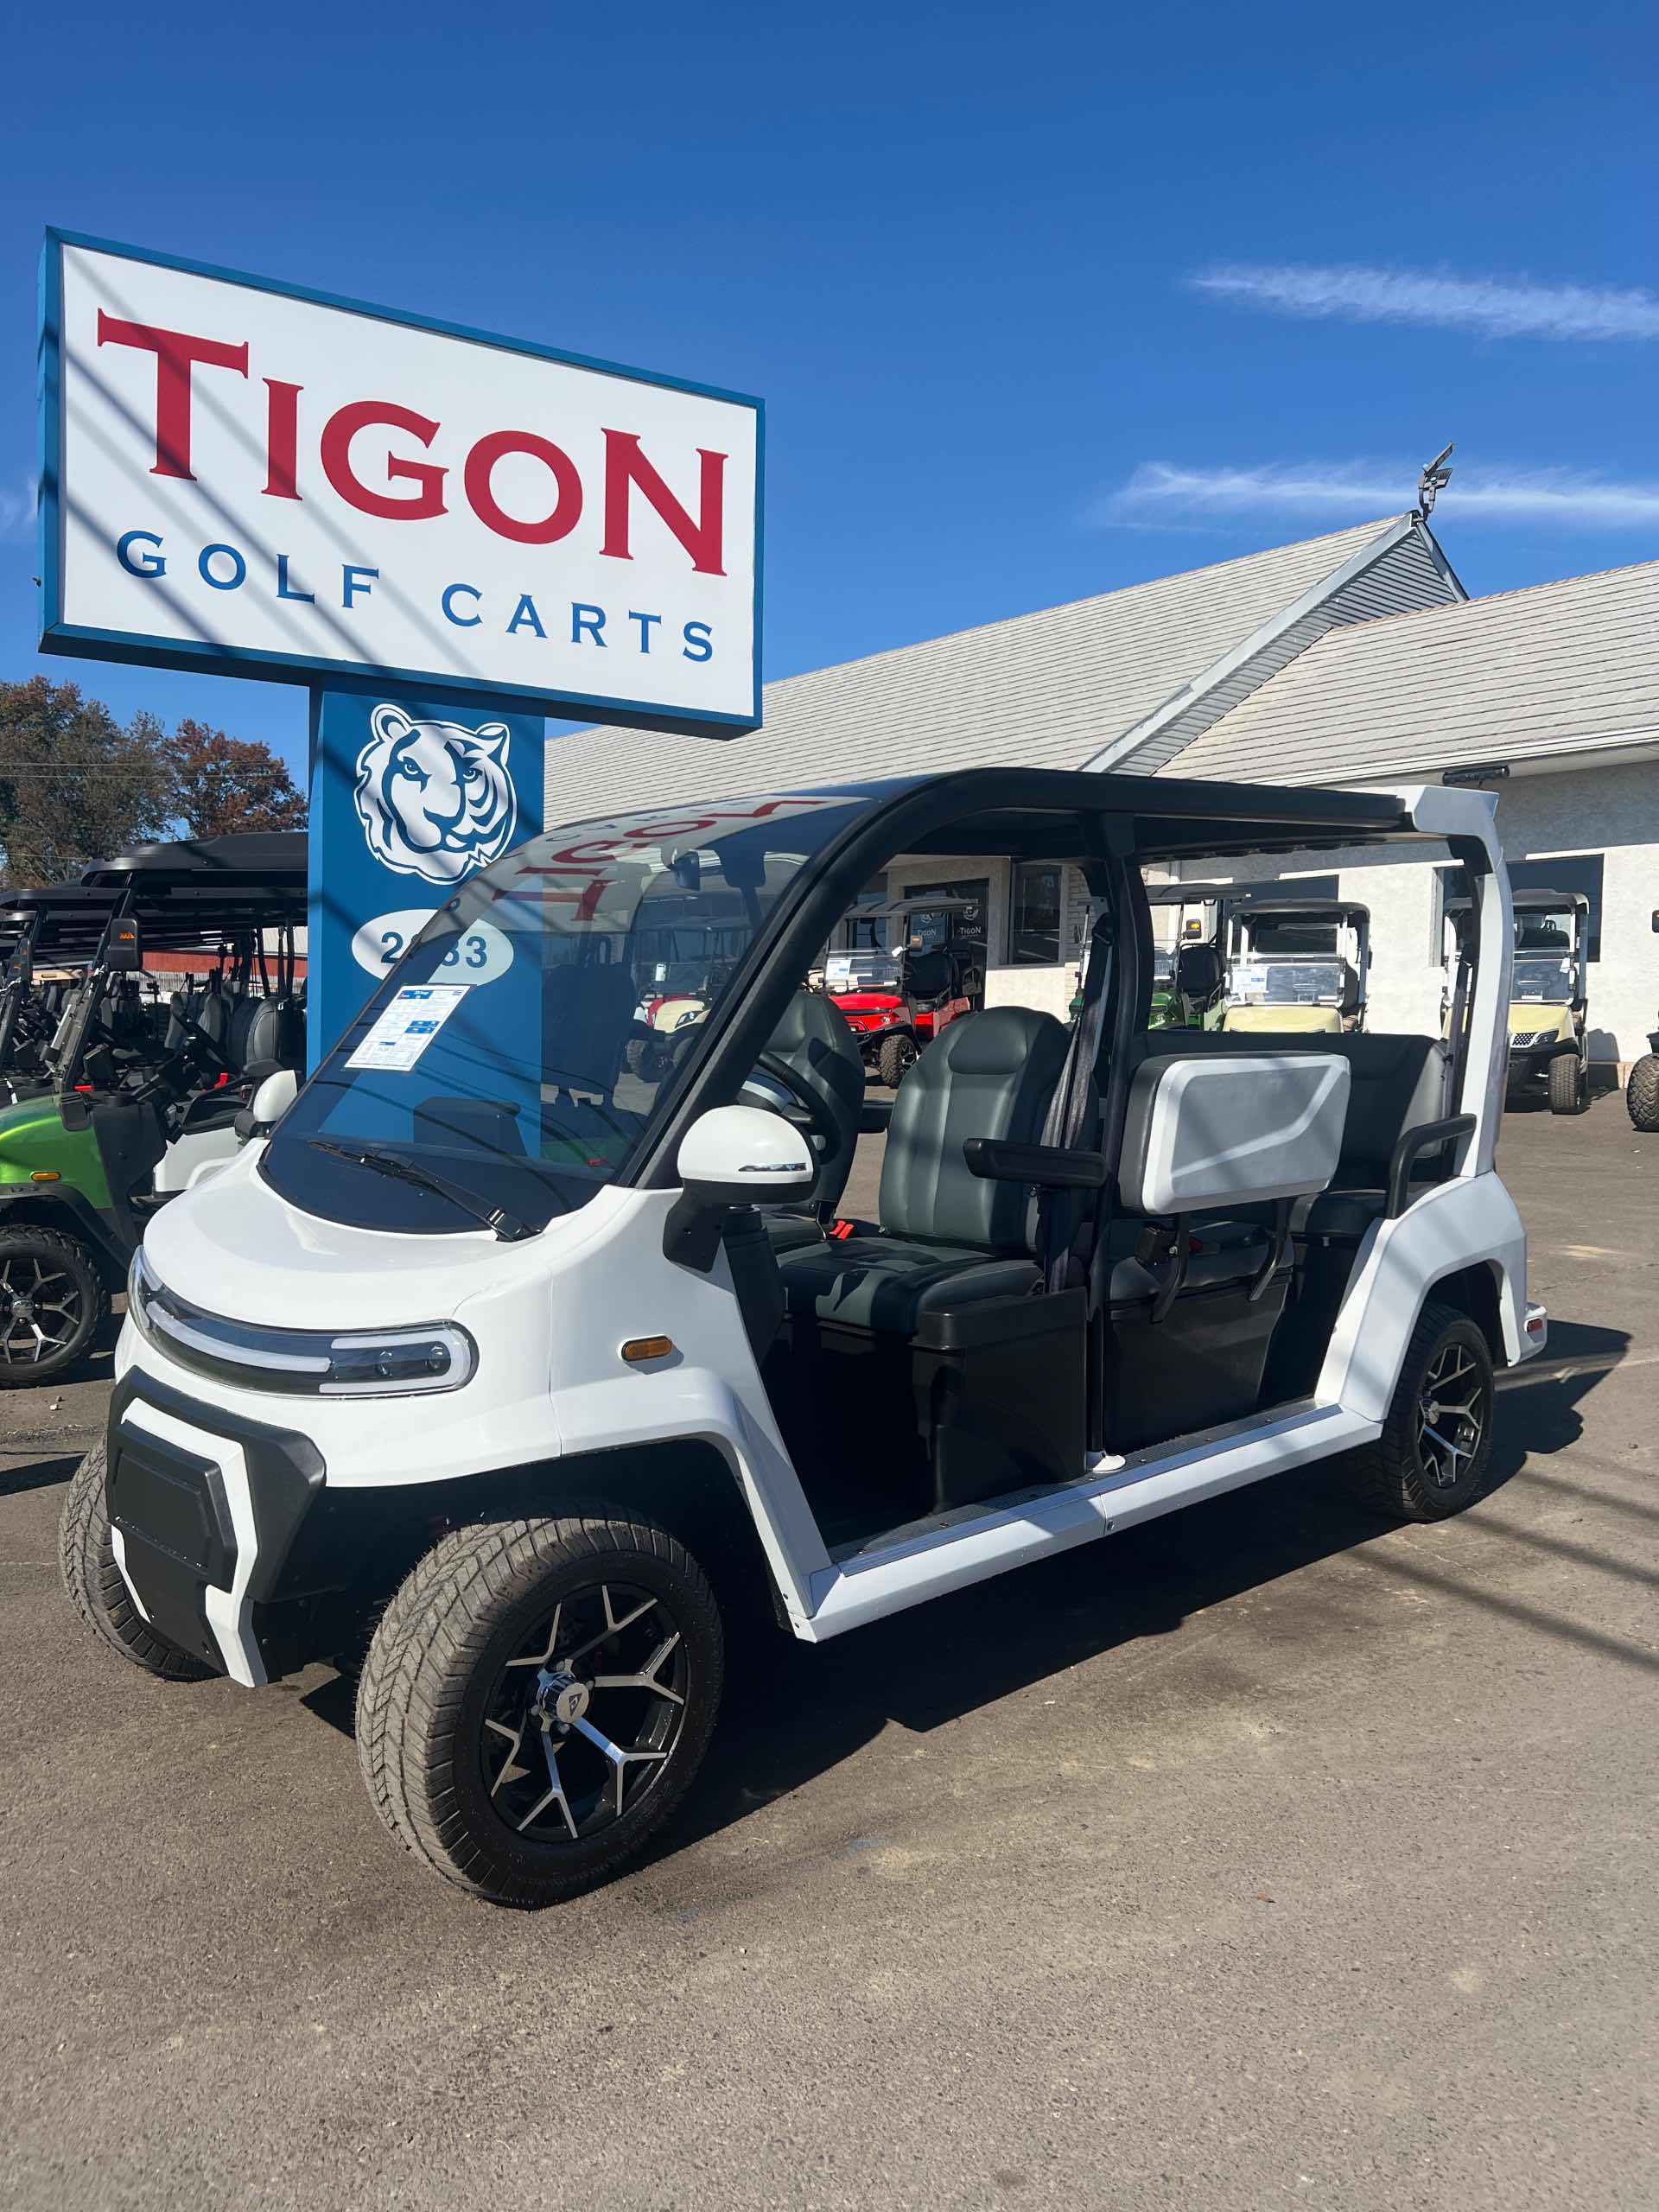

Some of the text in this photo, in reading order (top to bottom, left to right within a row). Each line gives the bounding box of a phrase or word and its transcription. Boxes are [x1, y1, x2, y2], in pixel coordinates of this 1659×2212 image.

[97, 308, 728, 577] TIGON
[116, 530, 714, 663] GOLF CARTS
